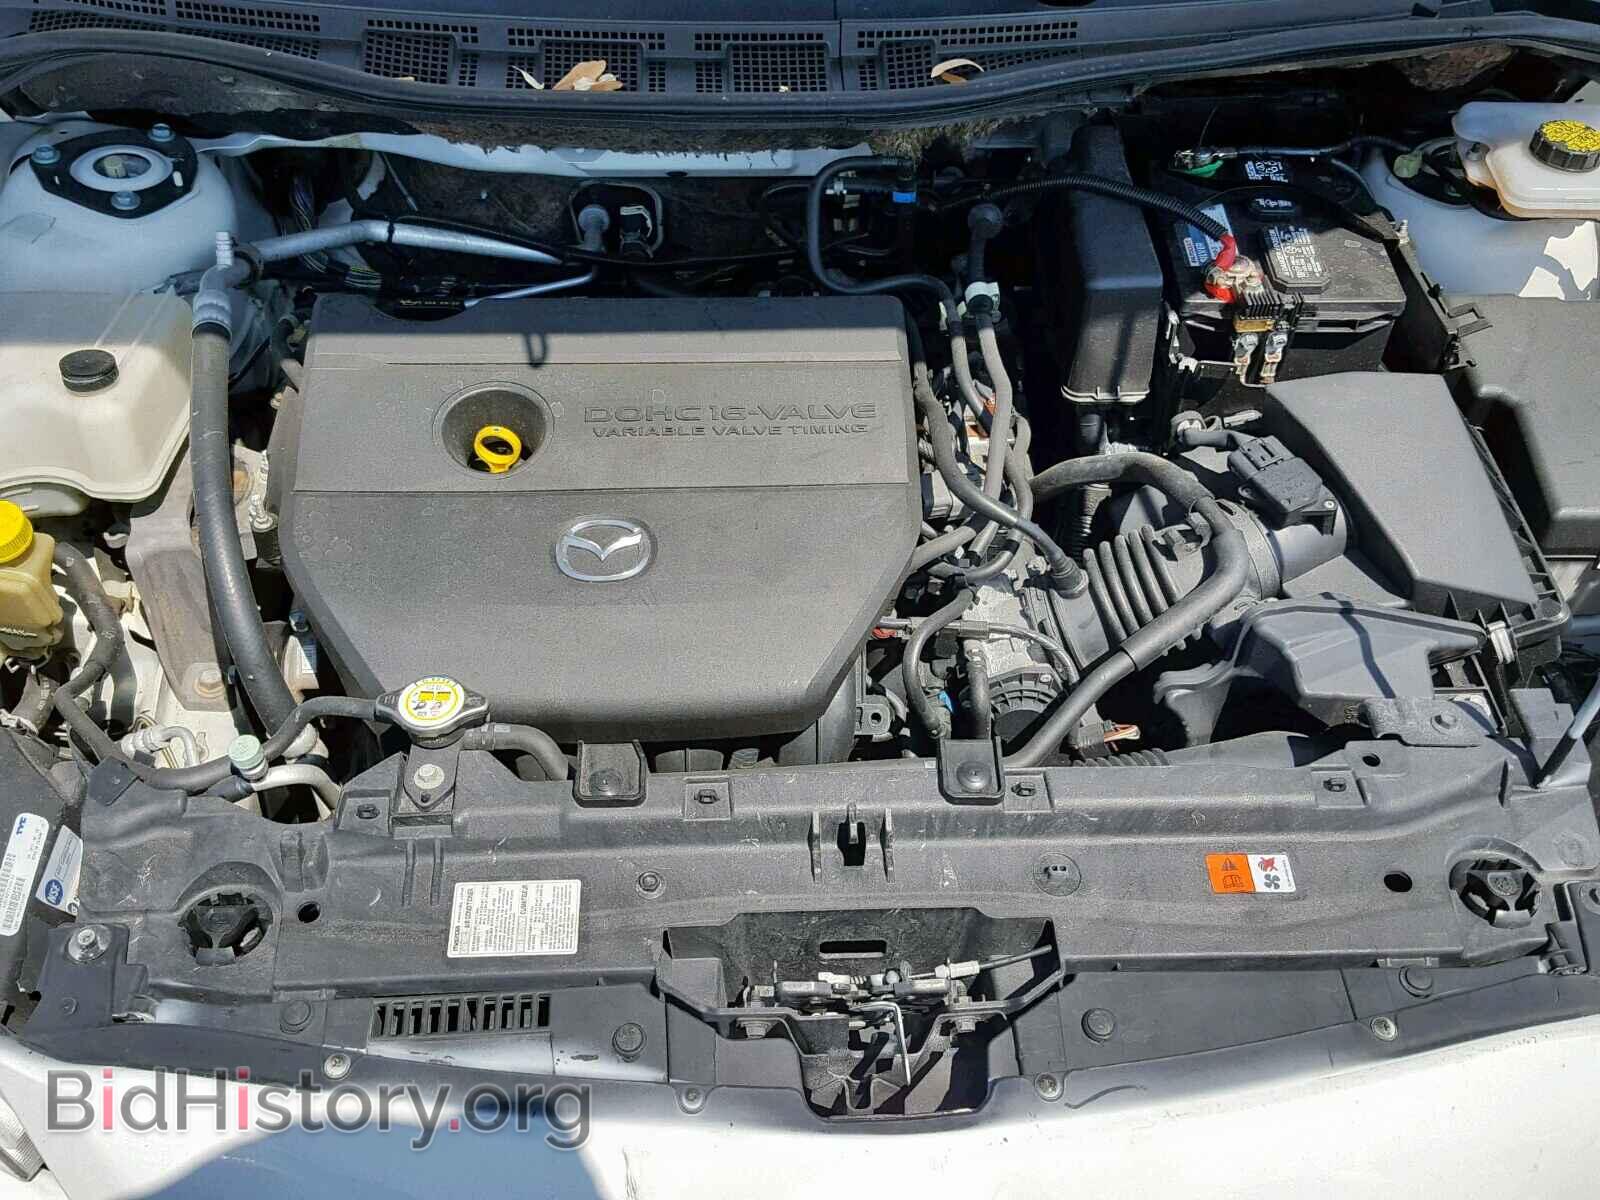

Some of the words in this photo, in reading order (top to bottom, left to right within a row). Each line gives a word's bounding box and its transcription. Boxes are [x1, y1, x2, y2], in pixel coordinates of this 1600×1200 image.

[584, 405, 702, 423] DOHC
[592, 426, 705, 438] VARIABLE
[711, 425, 782, 436] VALVE
[788, 423, 869, 435] TIMING
